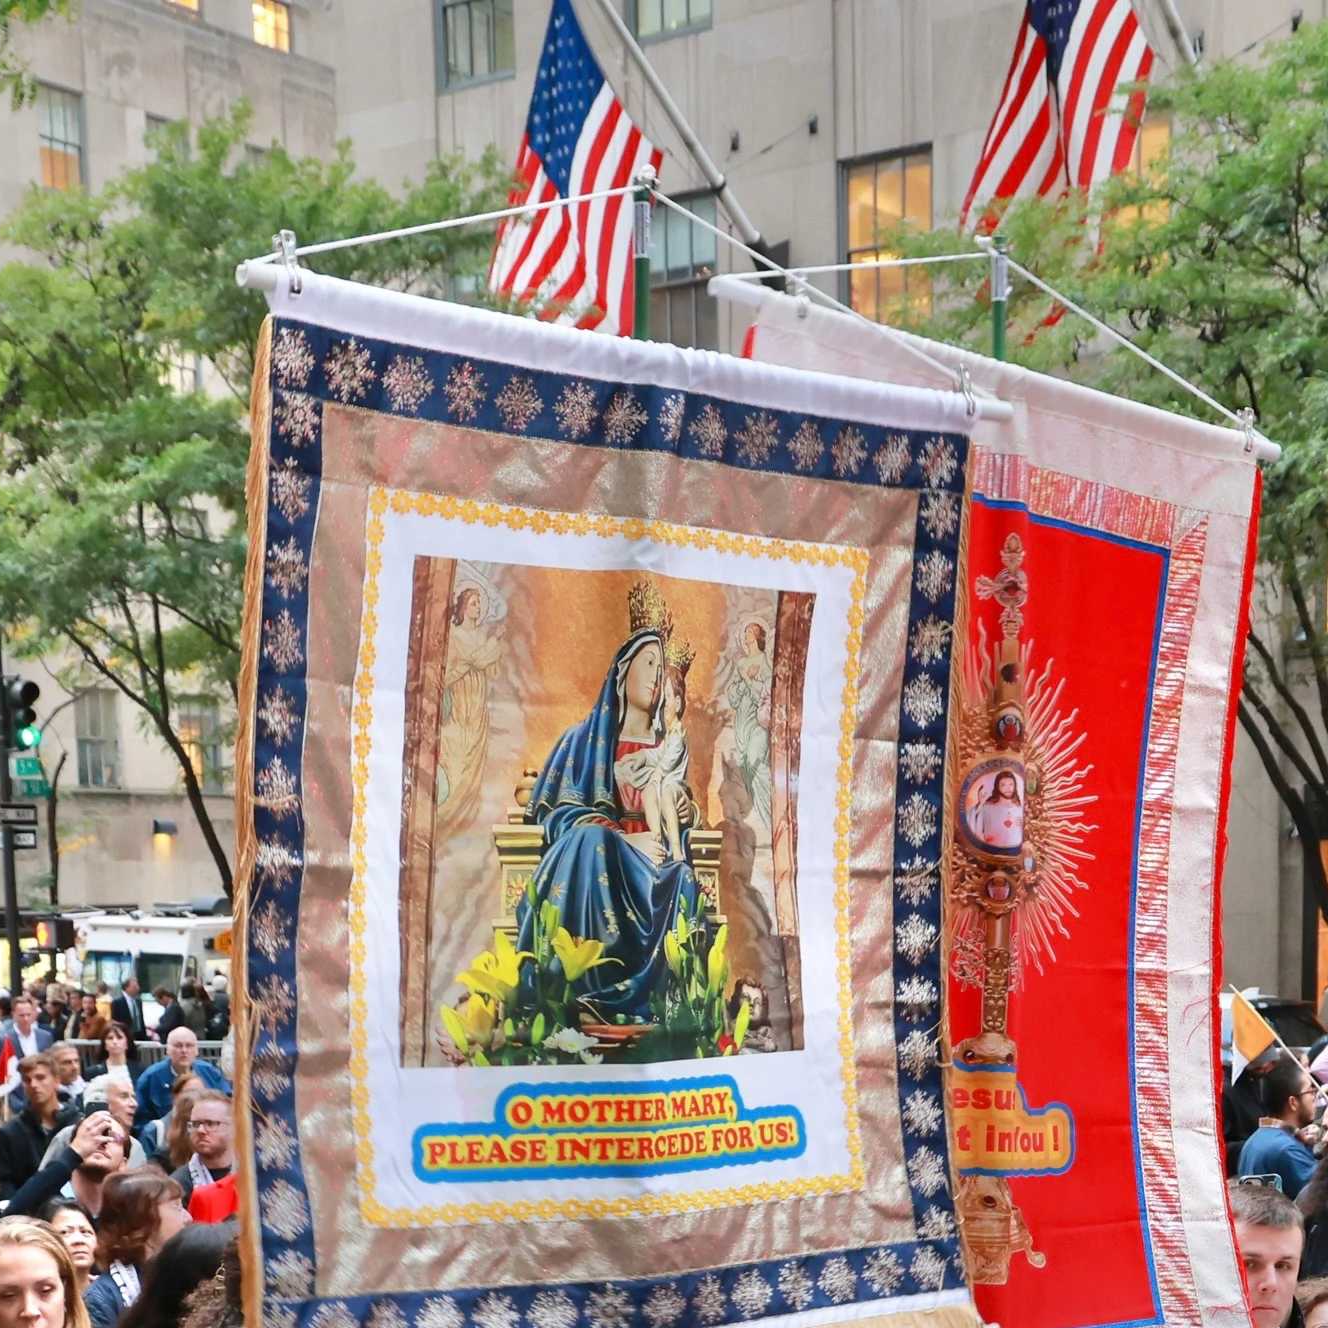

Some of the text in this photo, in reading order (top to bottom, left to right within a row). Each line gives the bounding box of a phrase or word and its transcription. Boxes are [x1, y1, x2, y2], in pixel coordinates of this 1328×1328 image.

[511, 1091, 735, 1125] O MOTHER MARY,
[952, 1087, 1016, 1110] esu
[427, 1121, 795, 1166] PLEASE INTERCEDE FOR US!
